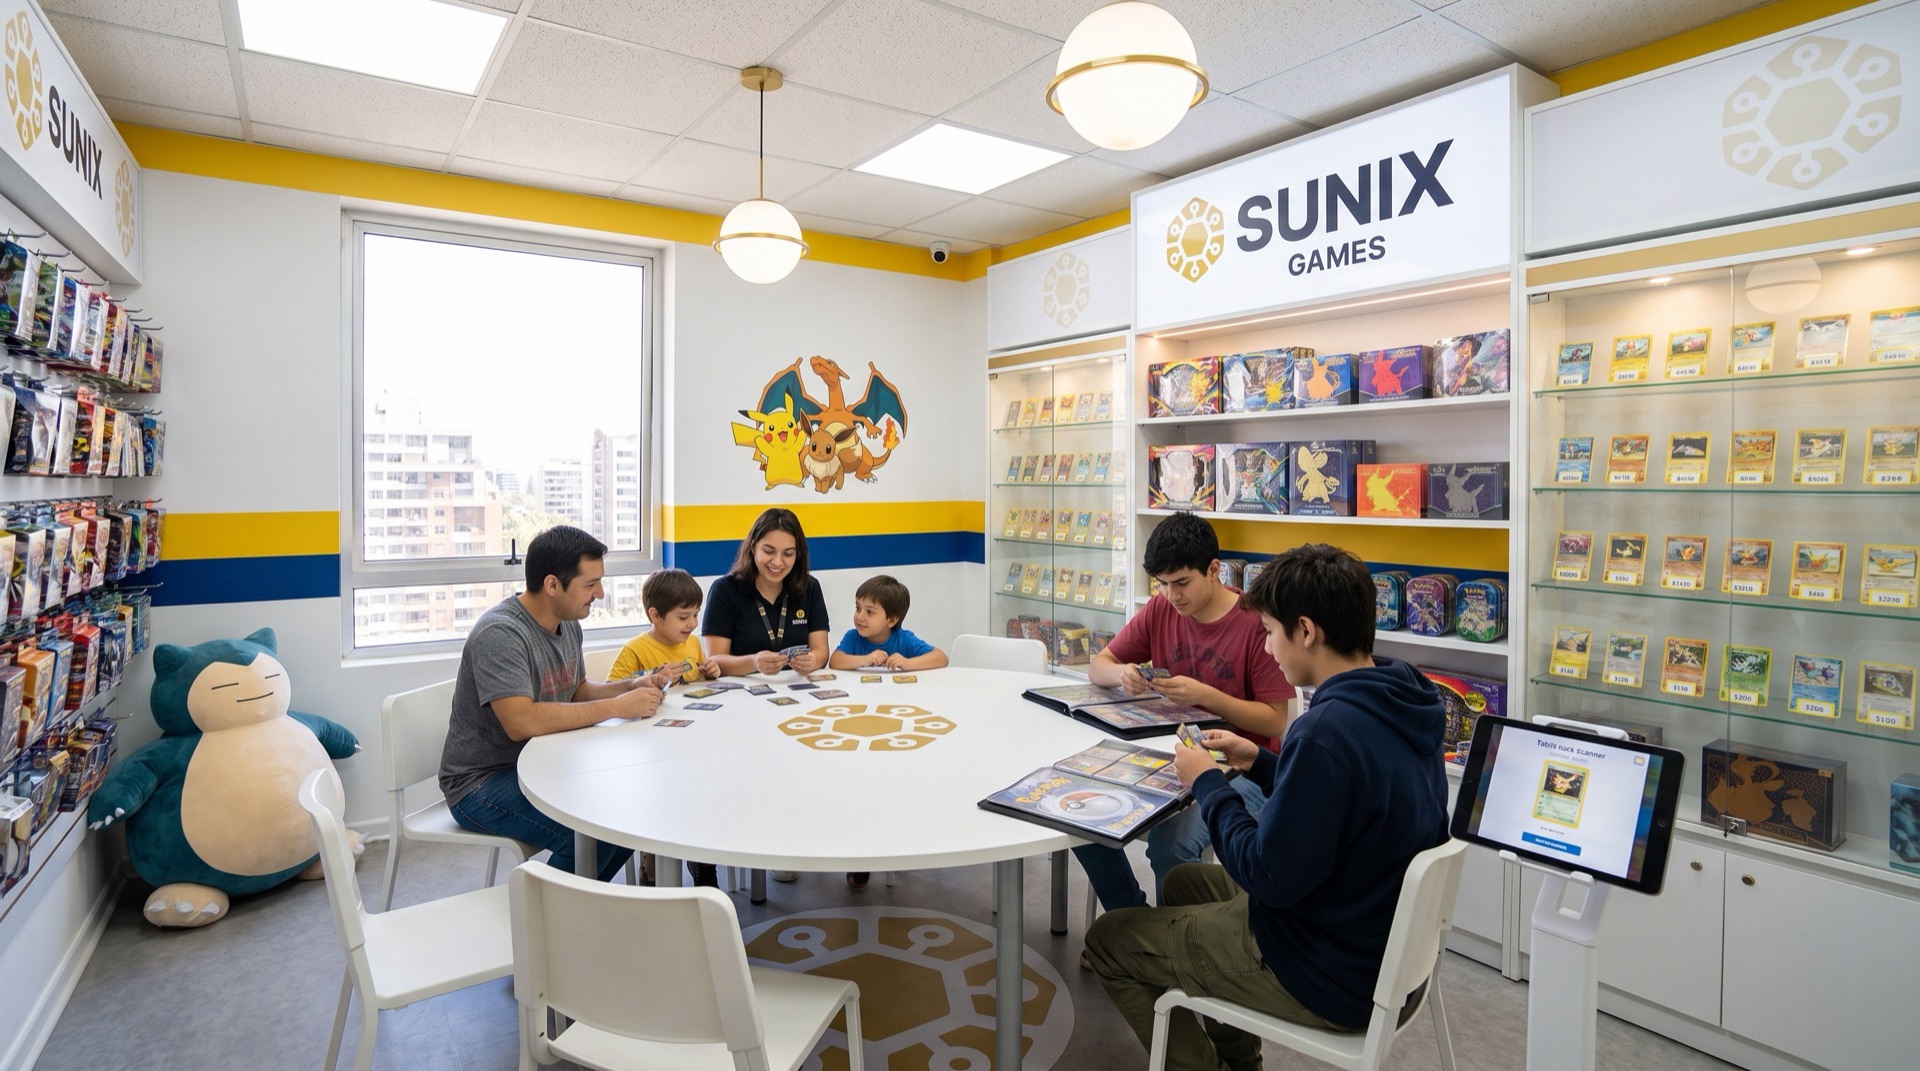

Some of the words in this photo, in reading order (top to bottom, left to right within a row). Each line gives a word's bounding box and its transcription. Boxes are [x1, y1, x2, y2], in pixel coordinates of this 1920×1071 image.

[48, 85, 103, 200] SUNIX
[1236, 138, 1454, 252] SUNIX
[1288, 235, 1386, 276] GAMES
